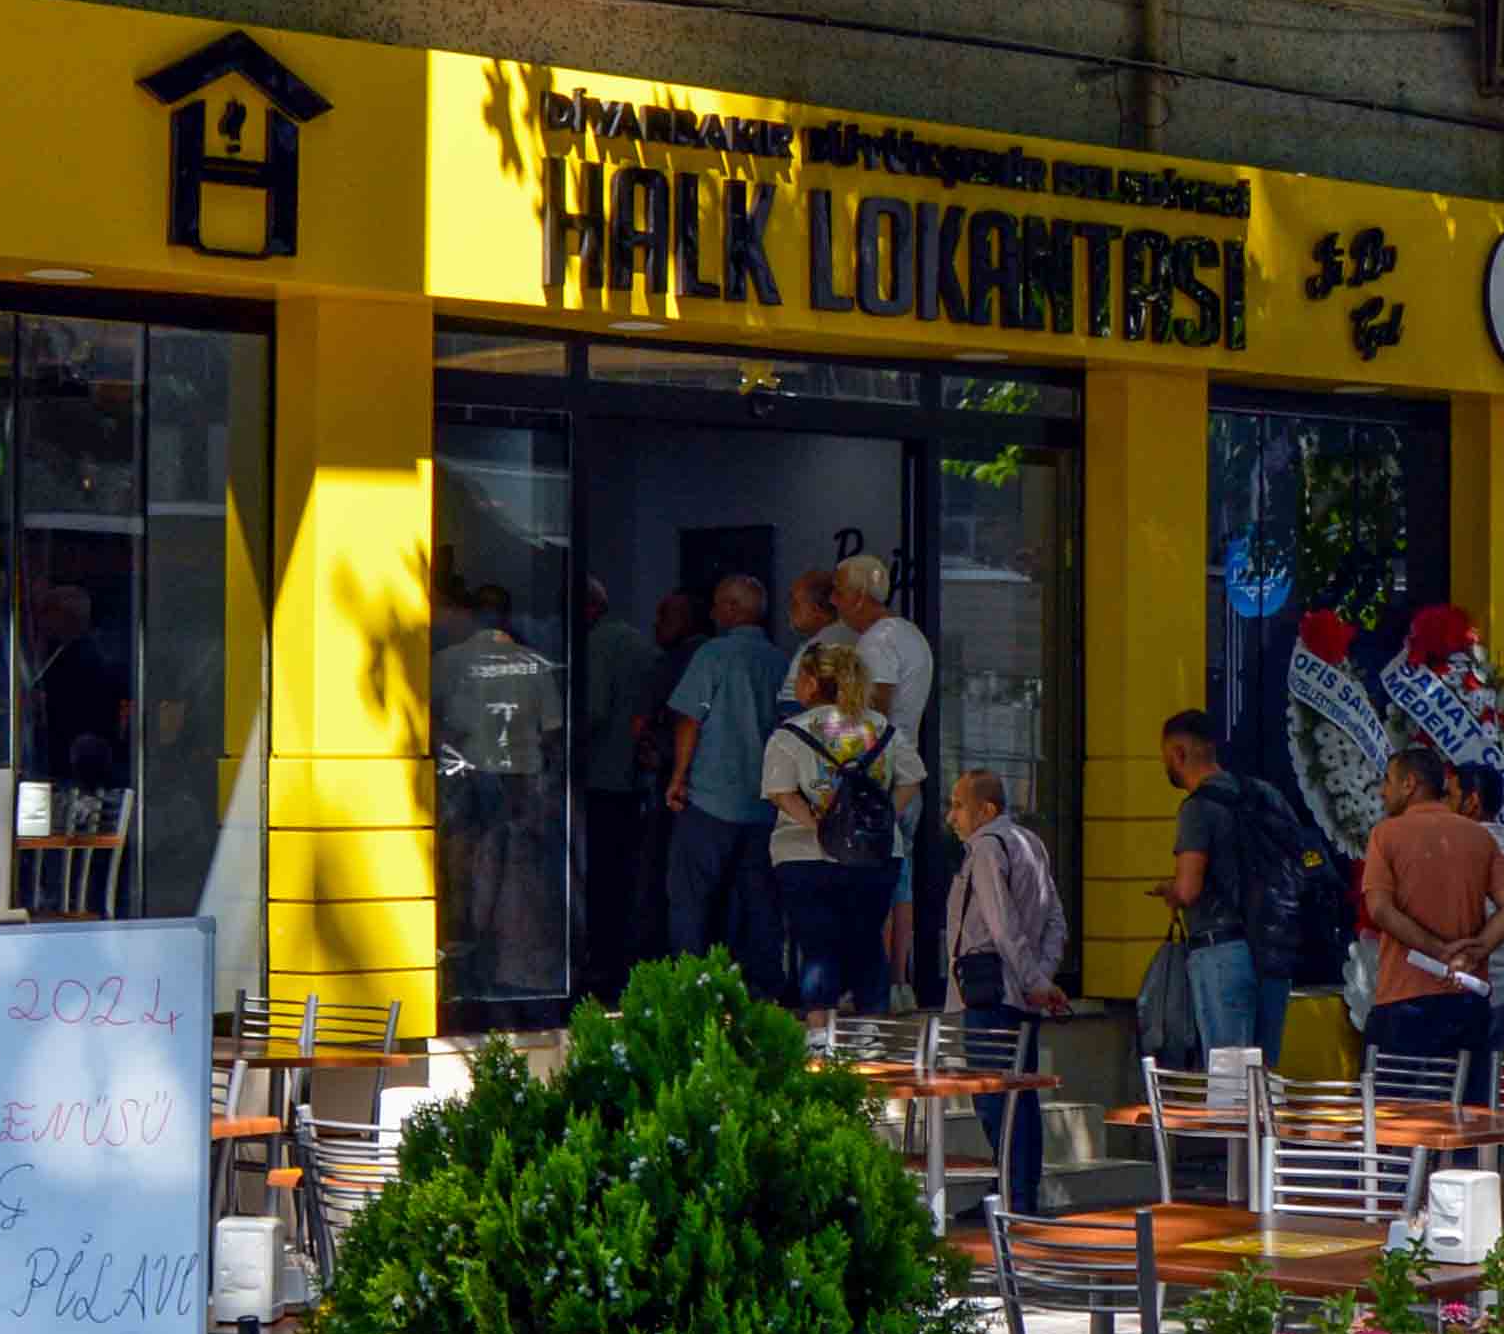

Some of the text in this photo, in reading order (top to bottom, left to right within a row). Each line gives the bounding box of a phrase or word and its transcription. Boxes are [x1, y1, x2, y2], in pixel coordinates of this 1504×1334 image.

[541, 154, 1248, 352] HALK LOKANTASI
[1399, 663, 1484, 740] SANAT
